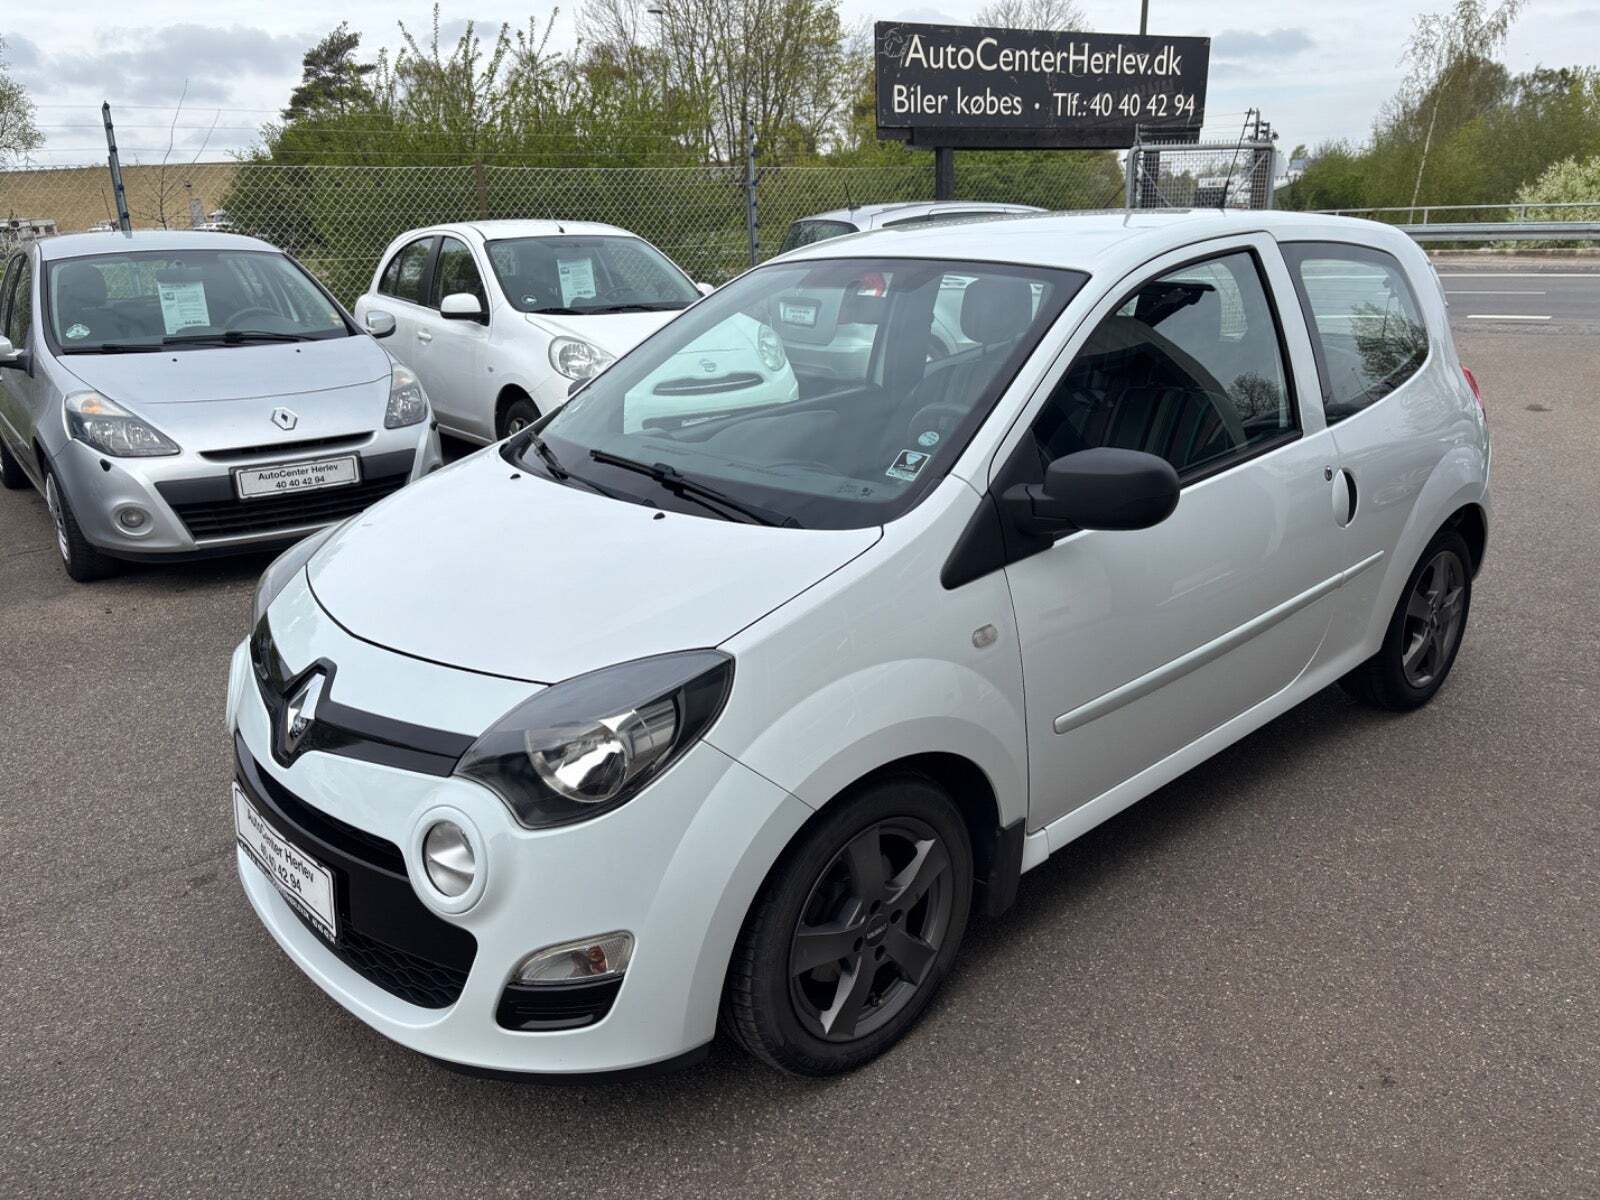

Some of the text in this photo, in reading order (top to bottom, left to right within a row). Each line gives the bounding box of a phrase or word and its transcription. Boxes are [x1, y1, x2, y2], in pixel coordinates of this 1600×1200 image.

[905, 34, 1182, 76] AutoCenterHerlev.dk
[893, 84, 947, 114] Biler
[956, 87, 1022, 115] købes
[1118, 92, 1140, 116] 40
[1146, 93, 1167, 116] 42
[1174, 93, 1196, 118] 94
[258, 463, 338, 481] AutoCenter Herlev
[276, 481, 287, 489] 40
[289, 479, 300, 487] 40
[302, 477, 313, 485] 42
[277, 863, 289, 884] 42
[290, 873, 302, 893] 94
[285, 848, 314, 883] Herlev
